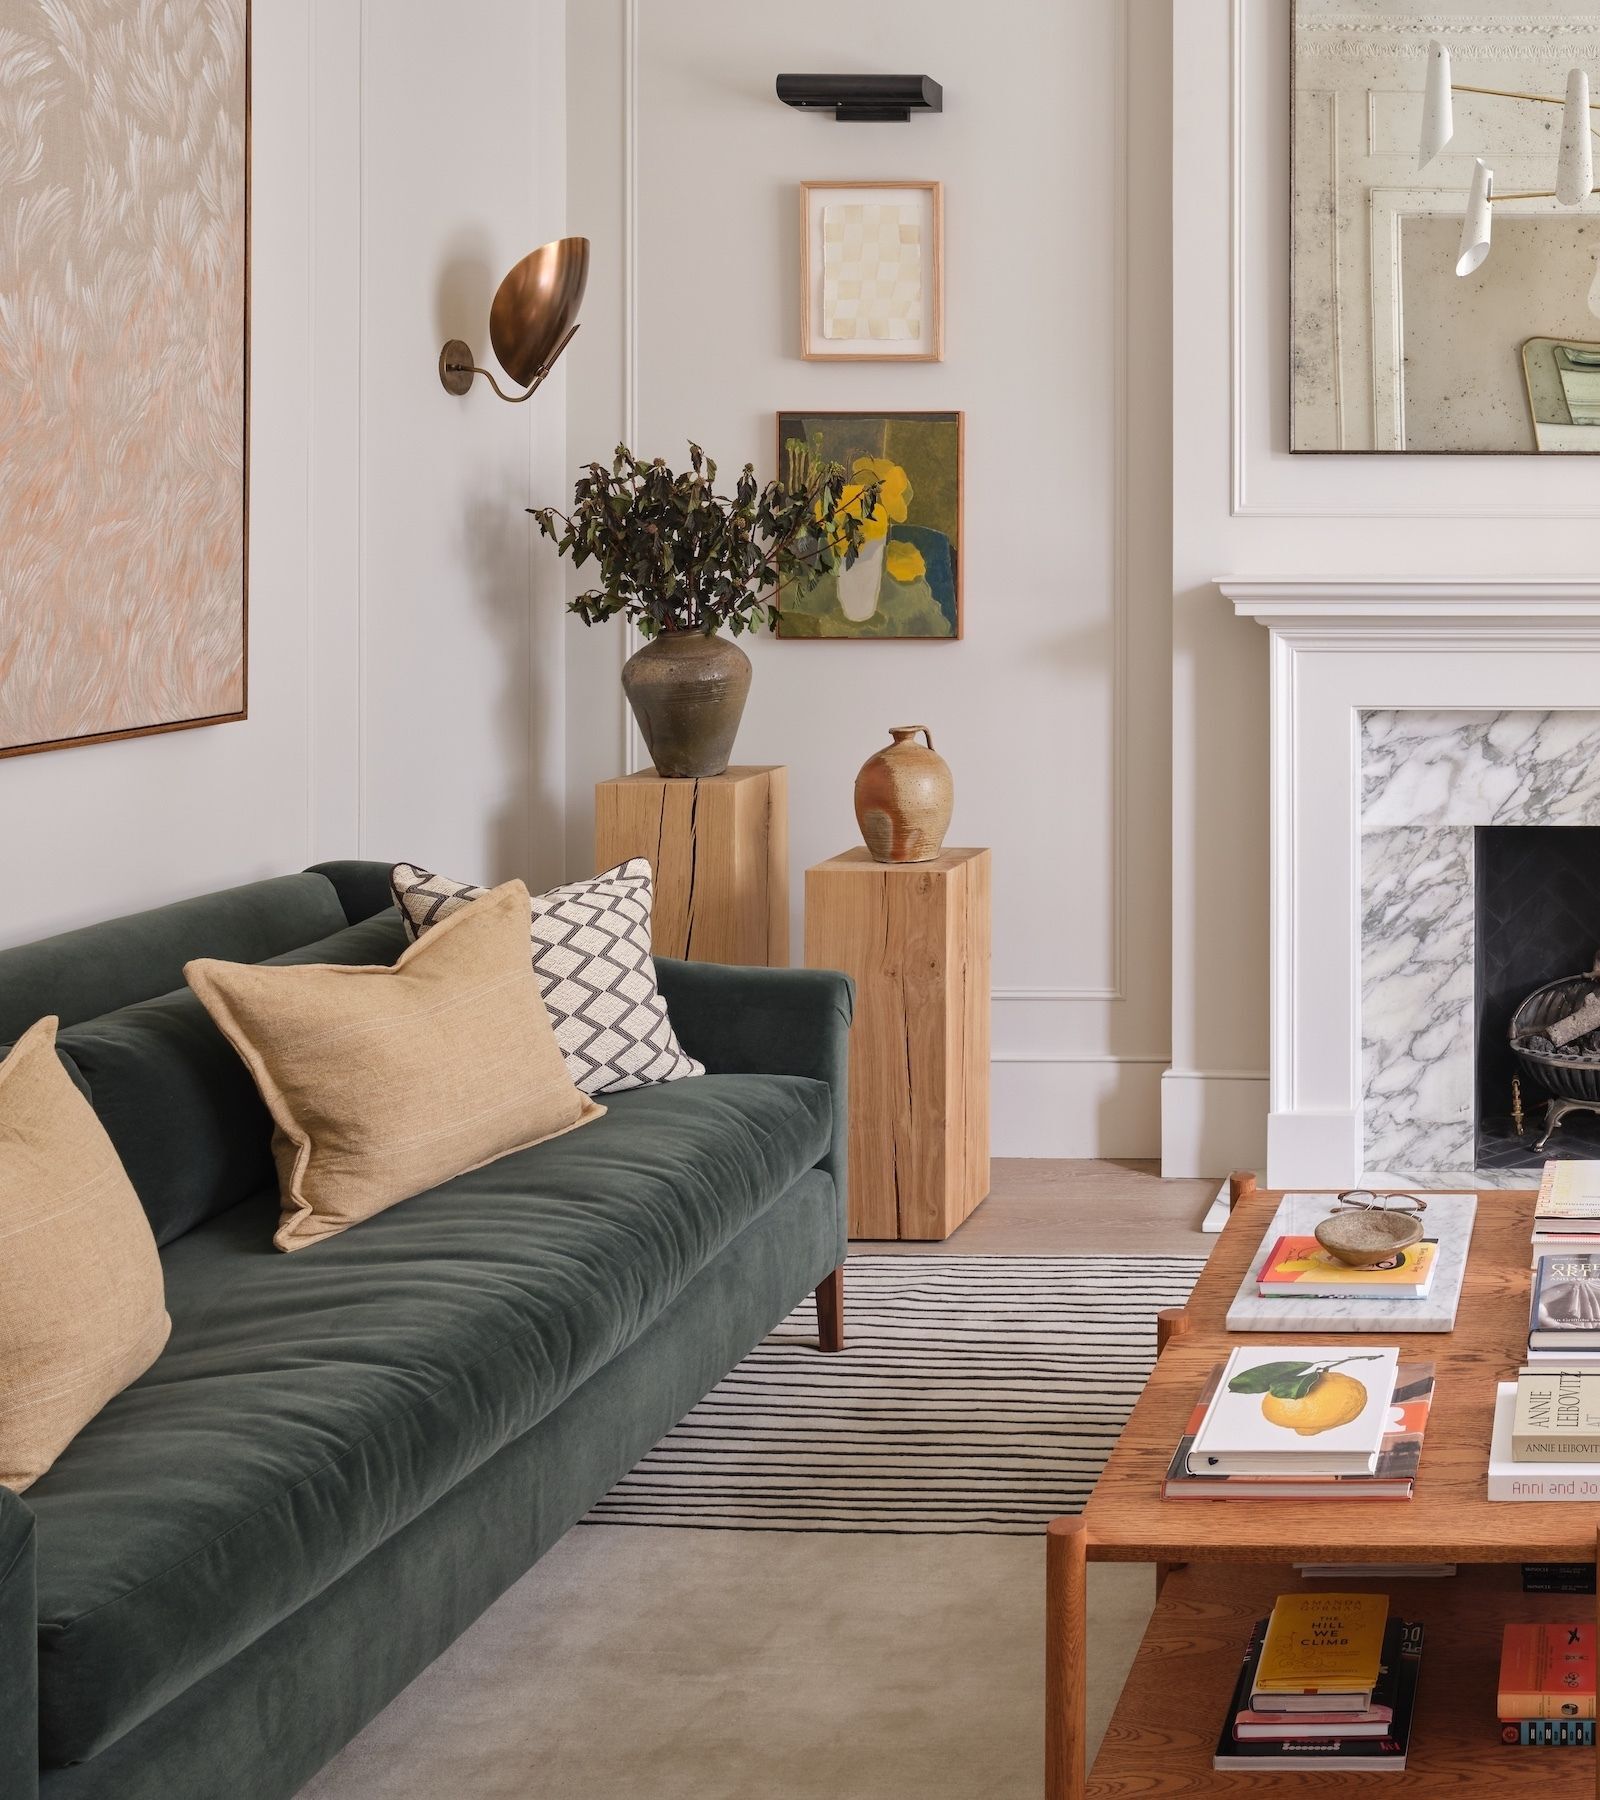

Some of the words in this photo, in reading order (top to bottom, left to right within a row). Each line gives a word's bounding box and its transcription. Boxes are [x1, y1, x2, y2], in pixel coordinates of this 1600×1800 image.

[1551, 1269, 1591, 1277] ART
[1556, 1371, 1582, 1427] LEIBOVITZ
[1528, 1391, 1552, 1428] ANNIE
[1525, 1443, 1556, 1453] ANNIE
[1512, 1480, 1544, 1495] Anni
[1549, 1480, 1575, 1495] and
